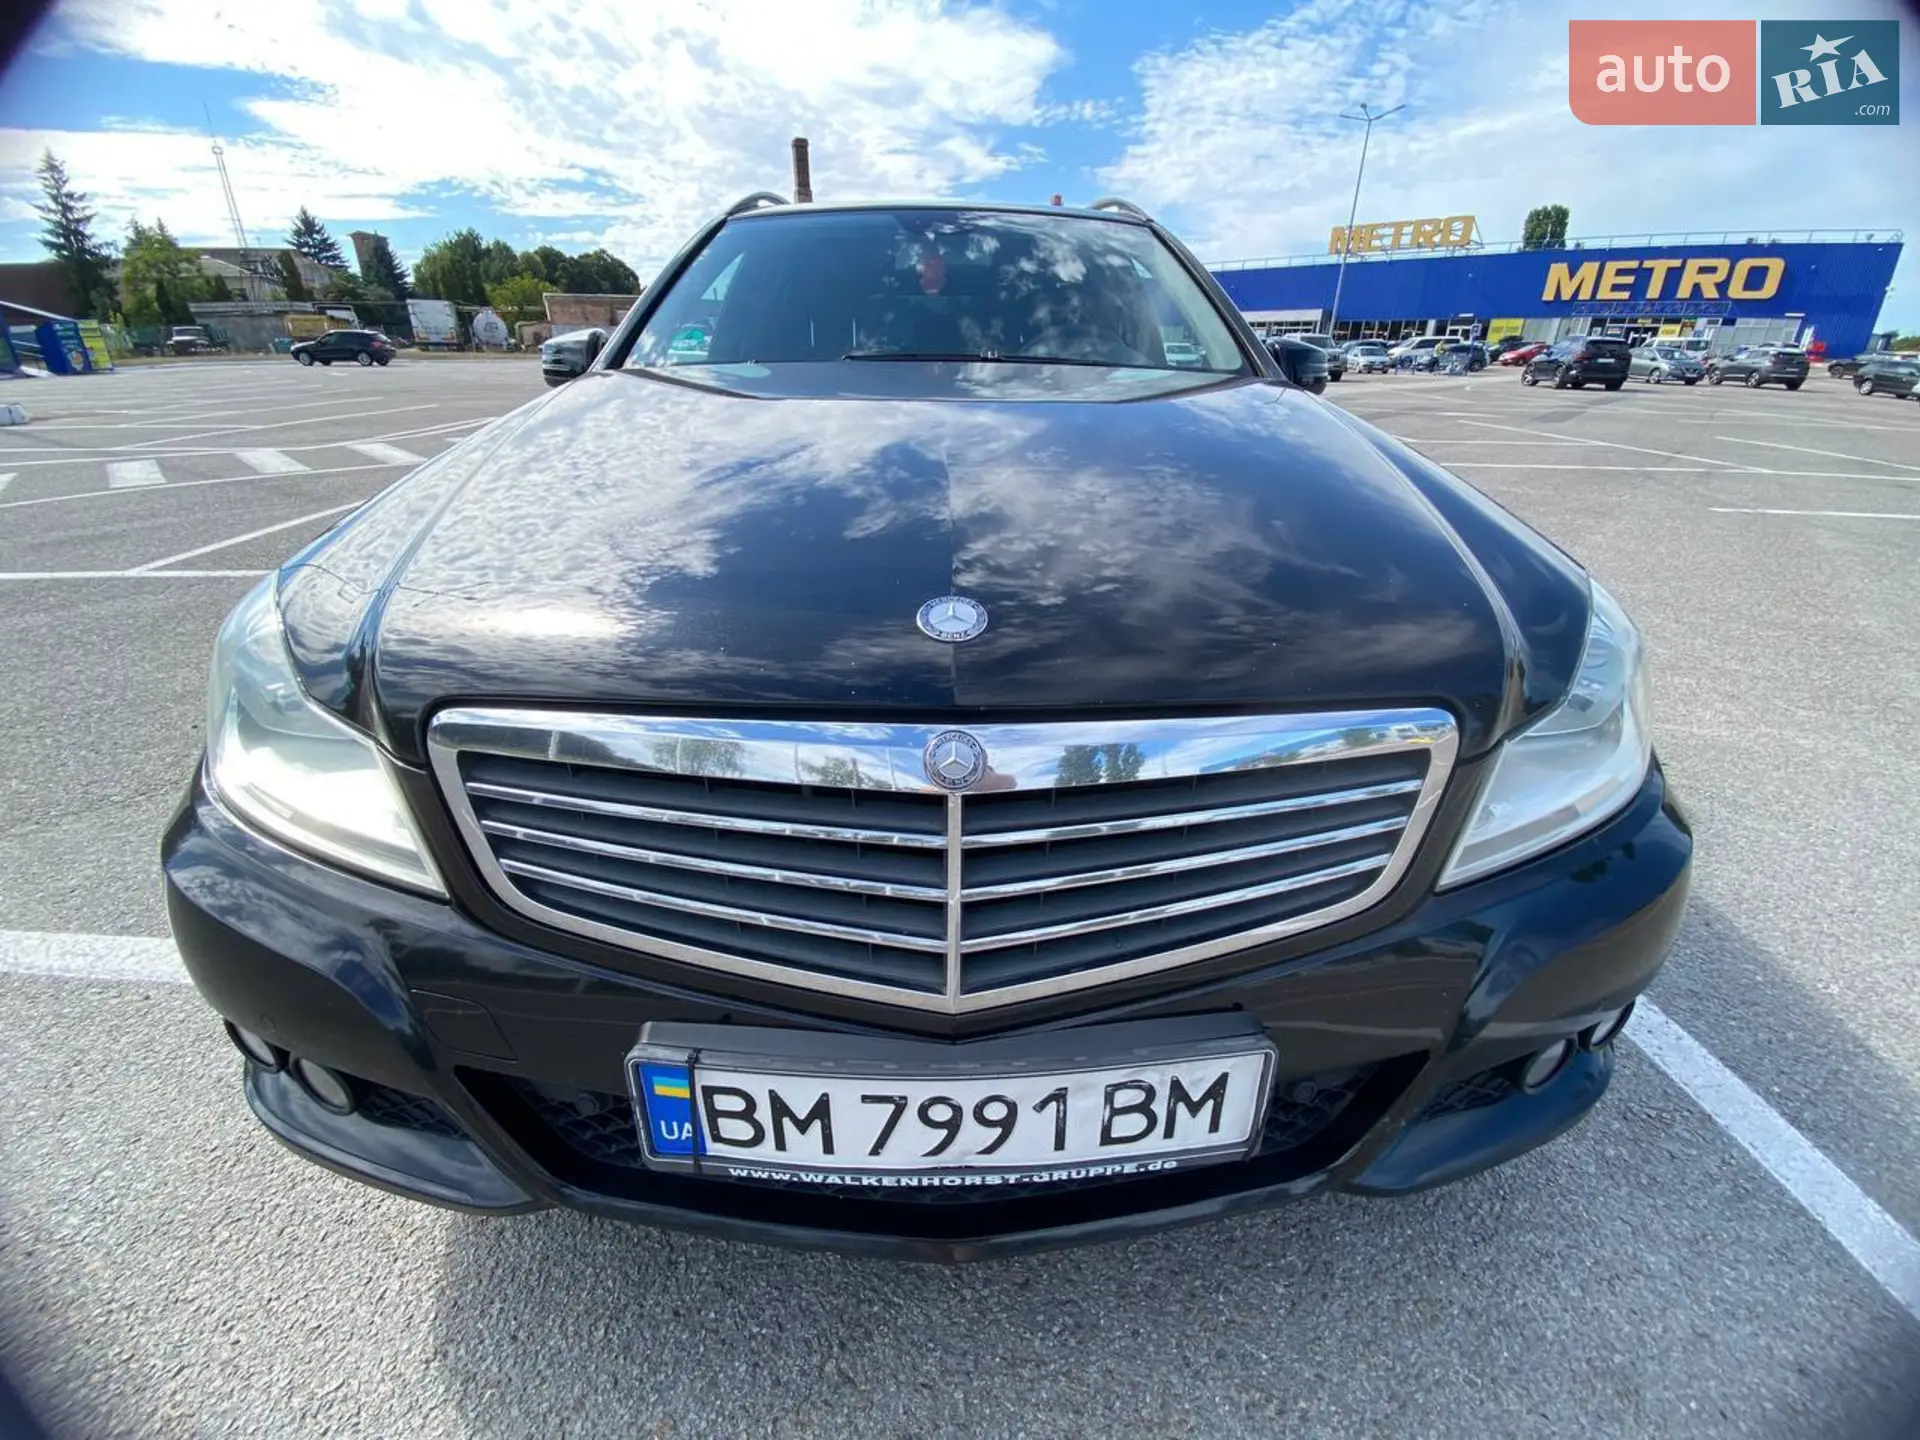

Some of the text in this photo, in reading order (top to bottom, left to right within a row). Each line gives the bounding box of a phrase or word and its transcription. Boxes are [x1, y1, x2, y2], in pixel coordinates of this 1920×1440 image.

[1328, 215, 1476, 255] METRO
[1541, 257, 1786, 301] METRO
[659, 1119, 693, 1141] UA
[701, 1071, 1230, 1158] BM 7991 BM
